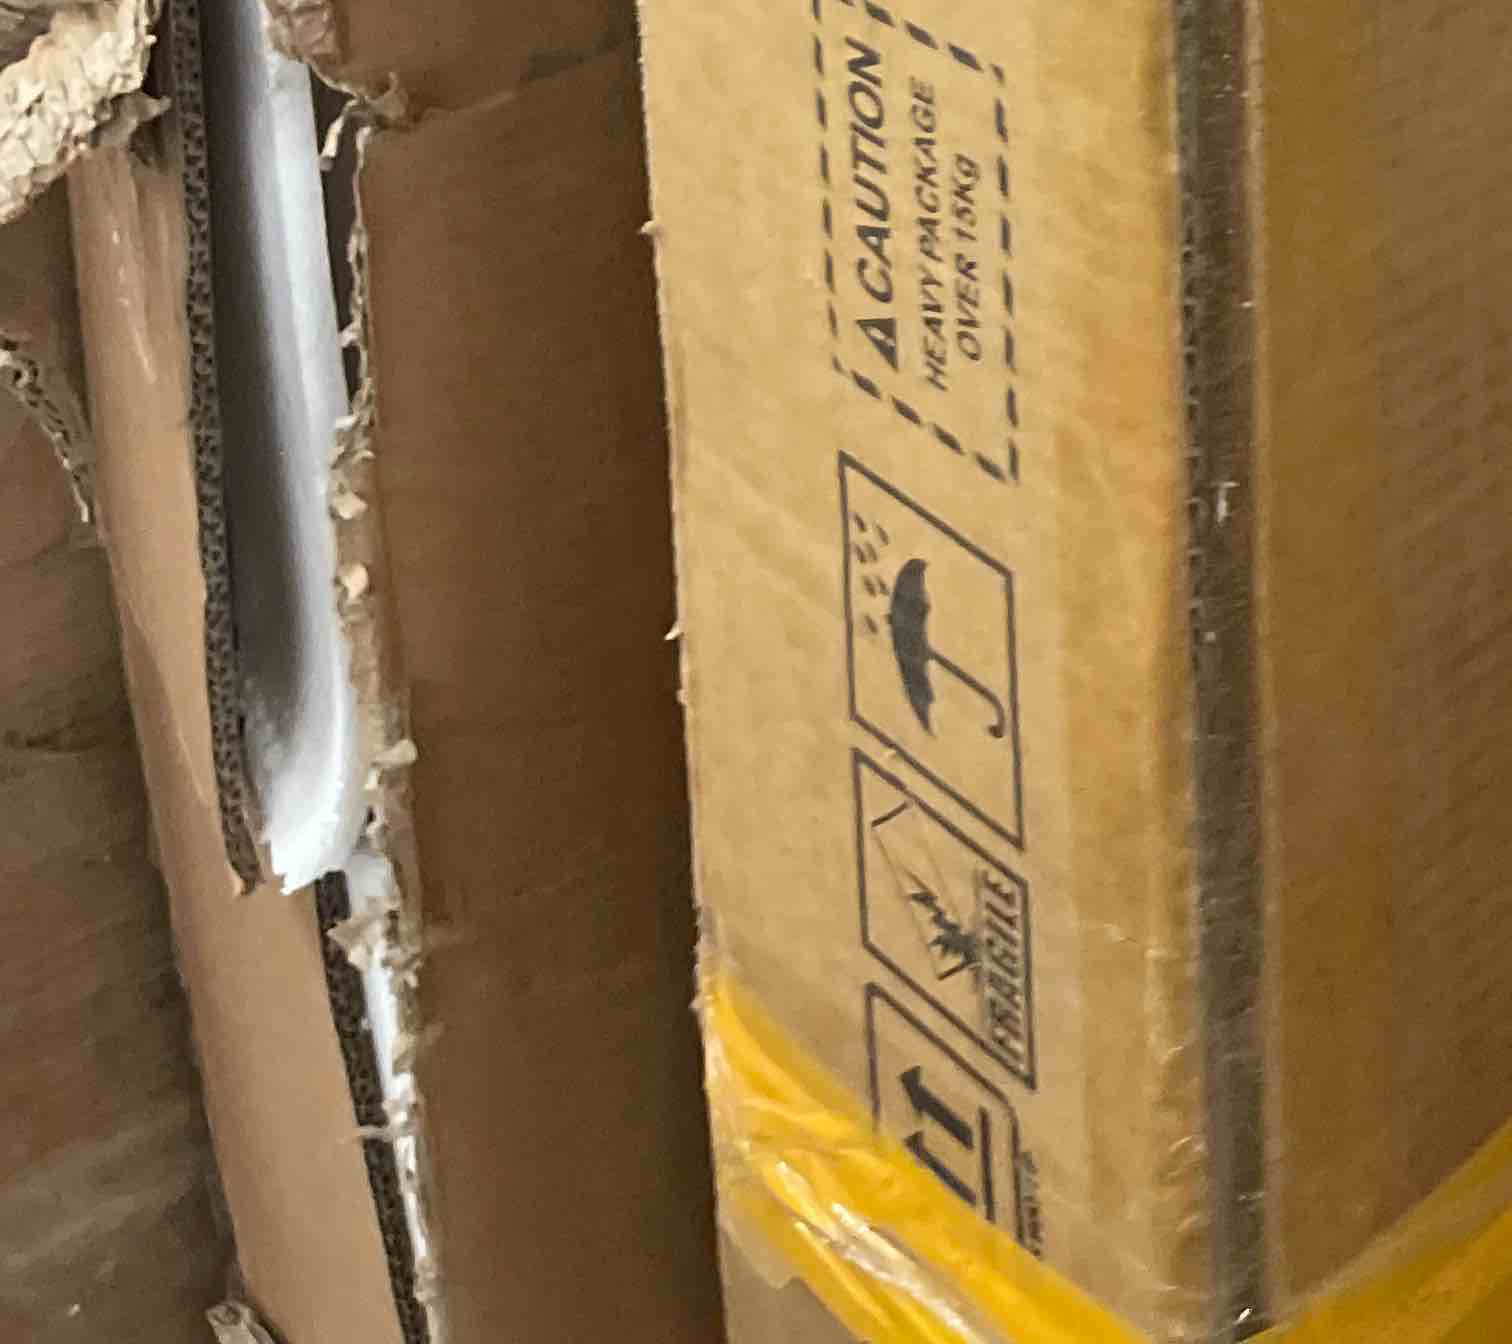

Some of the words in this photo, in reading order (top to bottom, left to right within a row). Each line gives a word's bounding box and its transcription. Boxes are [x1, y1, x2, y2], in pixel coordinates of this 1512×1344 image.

[844, 35, 896, 305] CAUTION
[909, 75, 944, 264] PACKAGE
[920, 264, 948, 392] HEAVY
[953, 253, 983, 362] OVER
